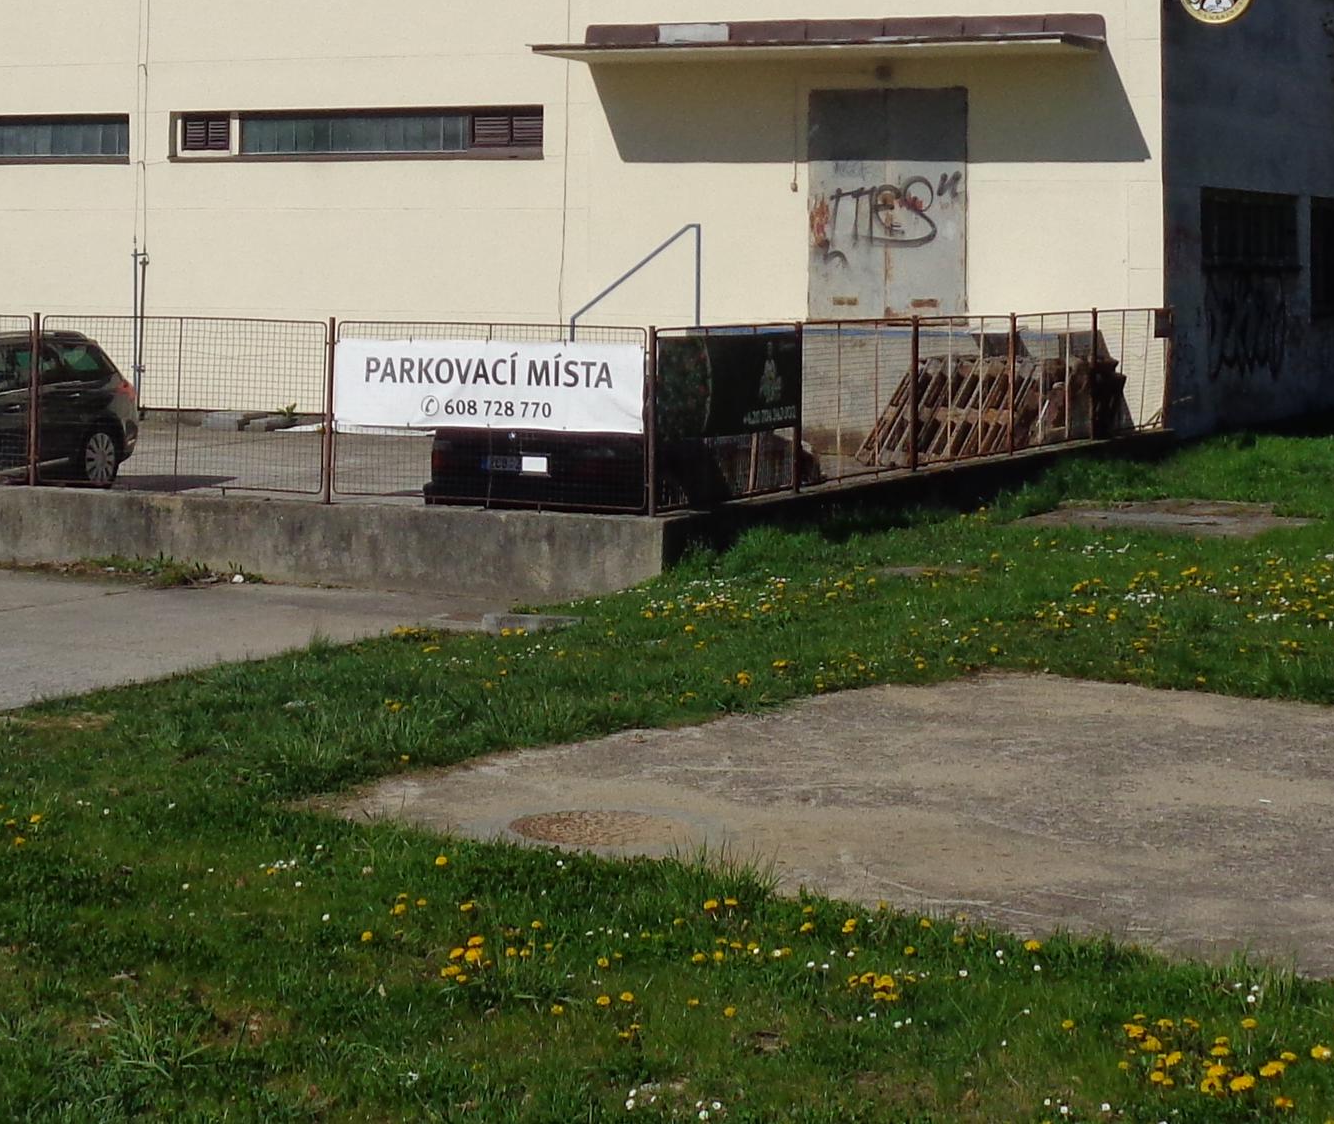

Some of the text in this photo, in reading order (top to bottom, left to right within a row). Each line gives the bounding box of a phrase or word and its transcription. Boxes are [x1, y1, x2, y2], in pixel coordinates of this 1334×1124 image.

[364, 352, 614, 389] PARKOVACÍ MÍSTA
[444, 398, 552, 418] 608 728 770
